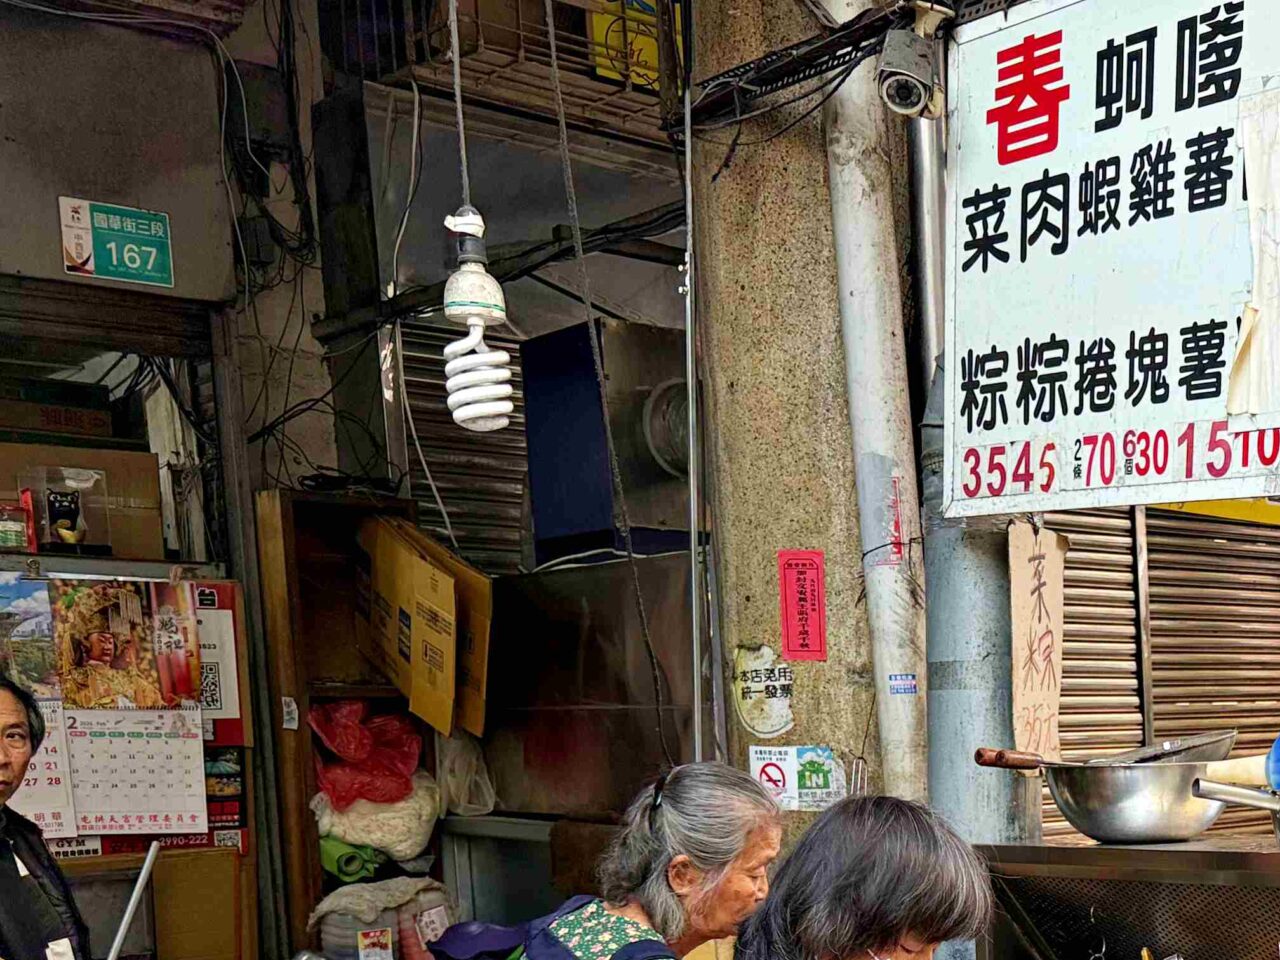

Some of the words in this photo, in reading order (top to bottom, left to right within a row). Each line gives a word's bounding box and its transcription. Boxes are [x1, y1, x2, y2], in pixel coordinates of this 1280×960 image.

[986, 30, 1071, 166] 春
[93, 212, 165, 238] 國華街三段
[106, 241, 158, 271] 167
[56, 838, 87, 848] GYM
